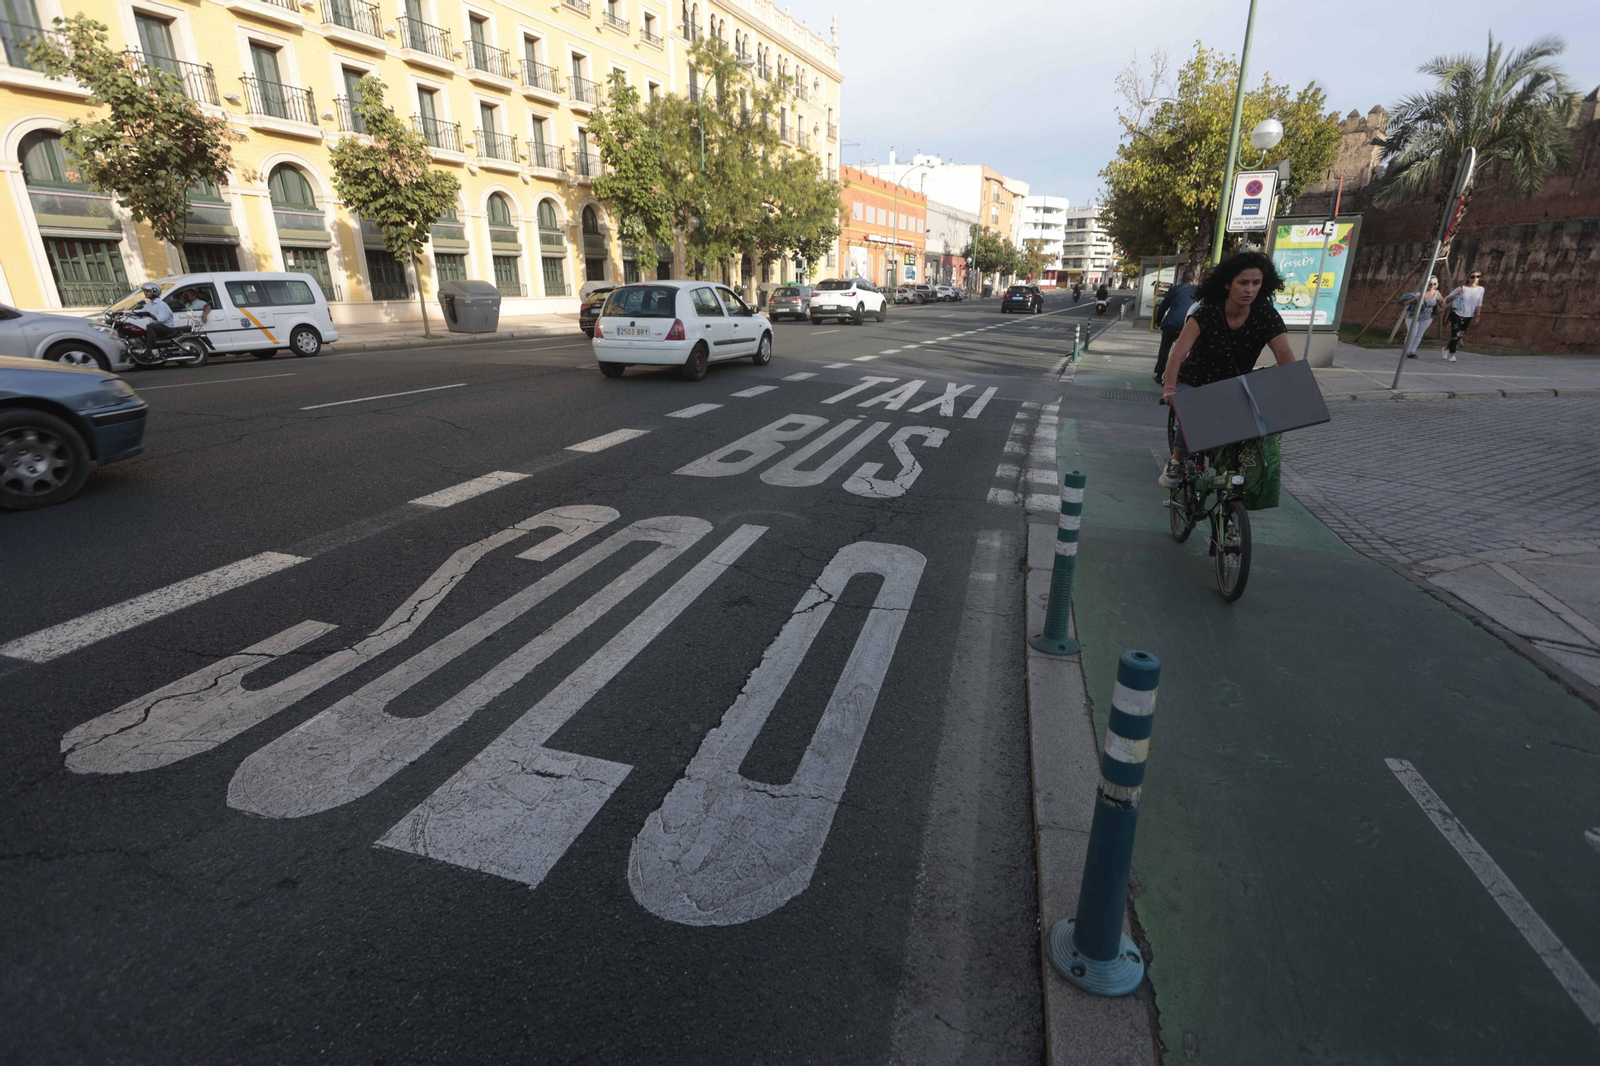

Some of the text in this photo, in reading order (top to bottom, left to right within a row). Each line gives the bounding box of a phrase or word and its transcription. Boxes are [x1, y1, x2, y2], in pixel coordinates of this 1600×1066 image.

[620, 328, 635, 336] 2503
[820, 376, 998, 419] TAXI
[671, 413, 950, 498] BUS
[60, 505, 927, 926] SOLO
